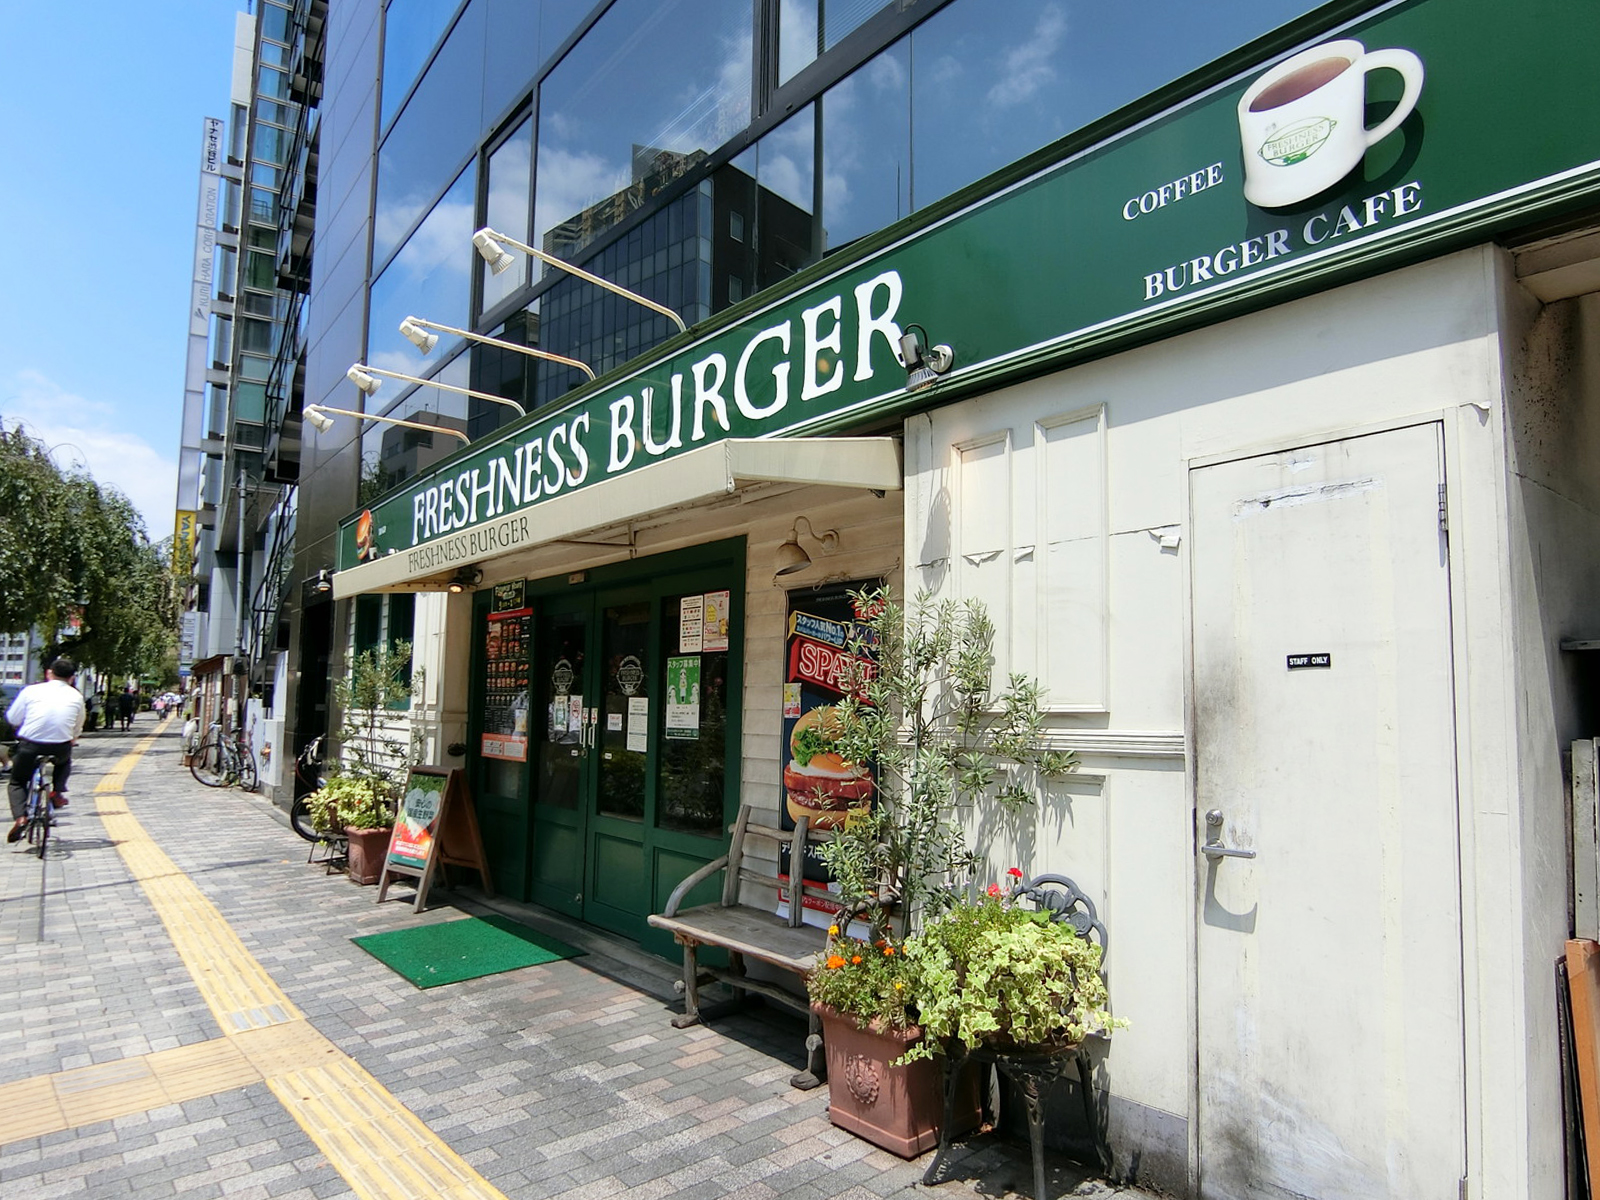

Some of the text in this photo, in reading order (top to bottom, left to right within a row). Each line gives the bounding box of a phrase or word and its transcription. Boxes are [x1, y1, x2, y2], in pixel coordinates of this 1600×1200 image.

[1267, 125, 1325, 151] FRESHNESS
[1273, 134, 1319, 157] BURGER
[202, 187, 216, 254] CORPORATION
[1122, 162, 1224, 221] COFFEE
[1143, 181, 1422, 301] BURGER CAFE
[411, 270, 906, 546] FRESHNESS BURGER
[408, 516, 531, 573] FRESHNESS BURGER
[1289, 656, 1328, 665] STAFF ONLY
